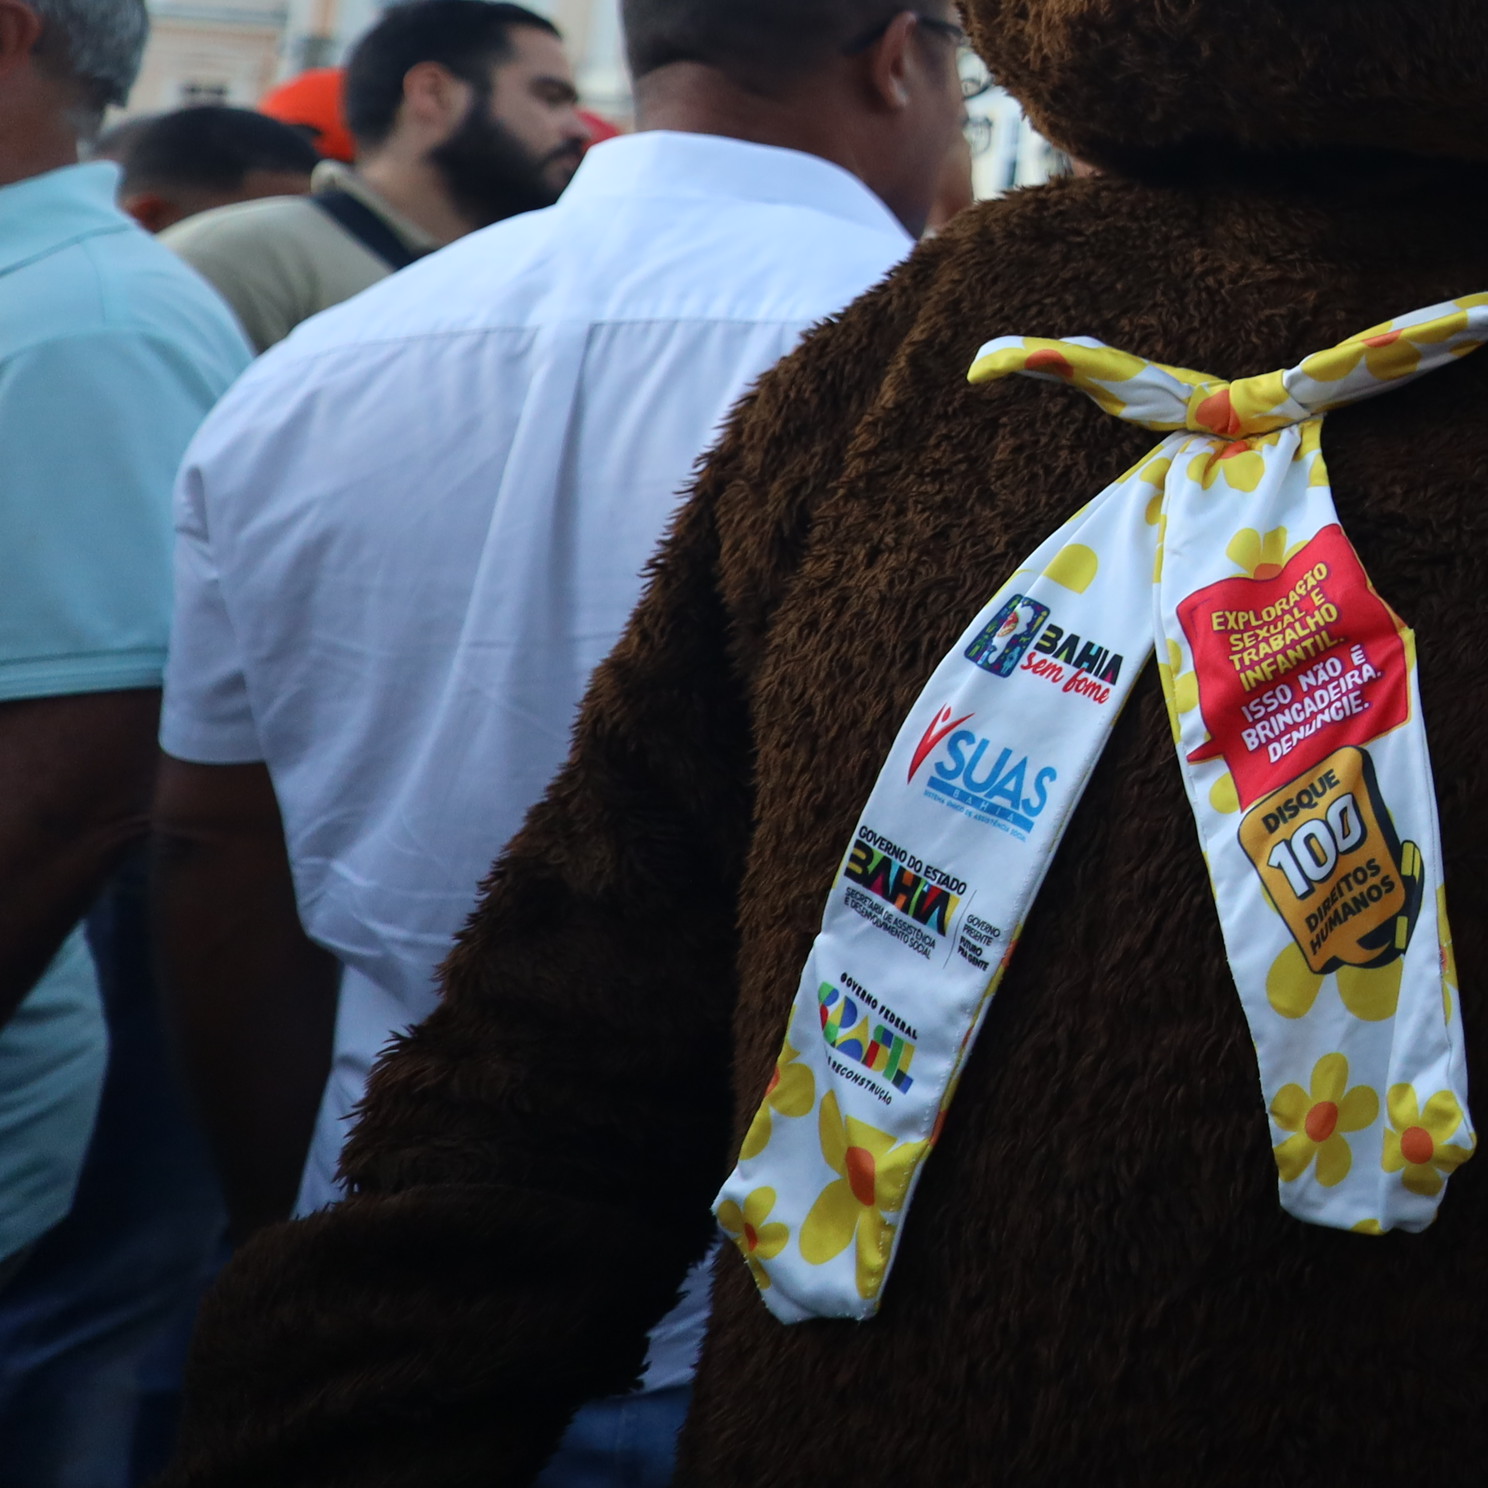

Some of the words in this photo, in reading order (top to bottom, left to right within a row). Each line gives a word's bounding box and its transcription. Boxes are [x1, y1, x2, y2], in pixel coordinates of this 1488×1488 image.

[1210, 562, 1328, 632] EXPLORAÇÃO
[1229, 606, 1306, 652] SEXUAL
[1310, 587, 1326, 607] E
[1033, 623, 1123, 686] BAHIA
[1228, 602, 1339, 671] TRABALHO
[1239, 629, 1345, 692] INFANTIL.
[1020, 651, 1065, 684] sem
[1062, 667, 1111, 704] fome
[1240, 663, 1382, 752] BRINCADEIRA.
[1241, 683, 1293, 723] ISSO
[1297, 656, 1343, 693] NÃO
[1350, 644, 1366, 667] É
[1267, 690, 1370, 764] DENUNCIE.
[933, 729, 1058, 818] SUAS
[952, 788, 1014, 823] BAHIA
[1261, 768, 1340, 834] DISQUE
[858, 825, 908, 863] GOVERNO
[907, 855, 923, 874] DO
[923, 866, 968, 896] ESTADO
[1267, 792, 1366, 901] 100
[844, 838, 960, 937] BAHIA
[845, 886, 885, 916] SECRETARIA
[882, 910, 894, 924] DE
[1304, 857, 1381, 934] DIREITOS
[1309, 875, 1396, 956] HUMANOS
[966, 913, 1002, 938] GOVERNO
[840, 971, 878, 1010] GOVERNO
[878, 1004, 918, 1041] FEDERAL
[831, 1060, 893, 1106] RECONSTRUÇÃO
